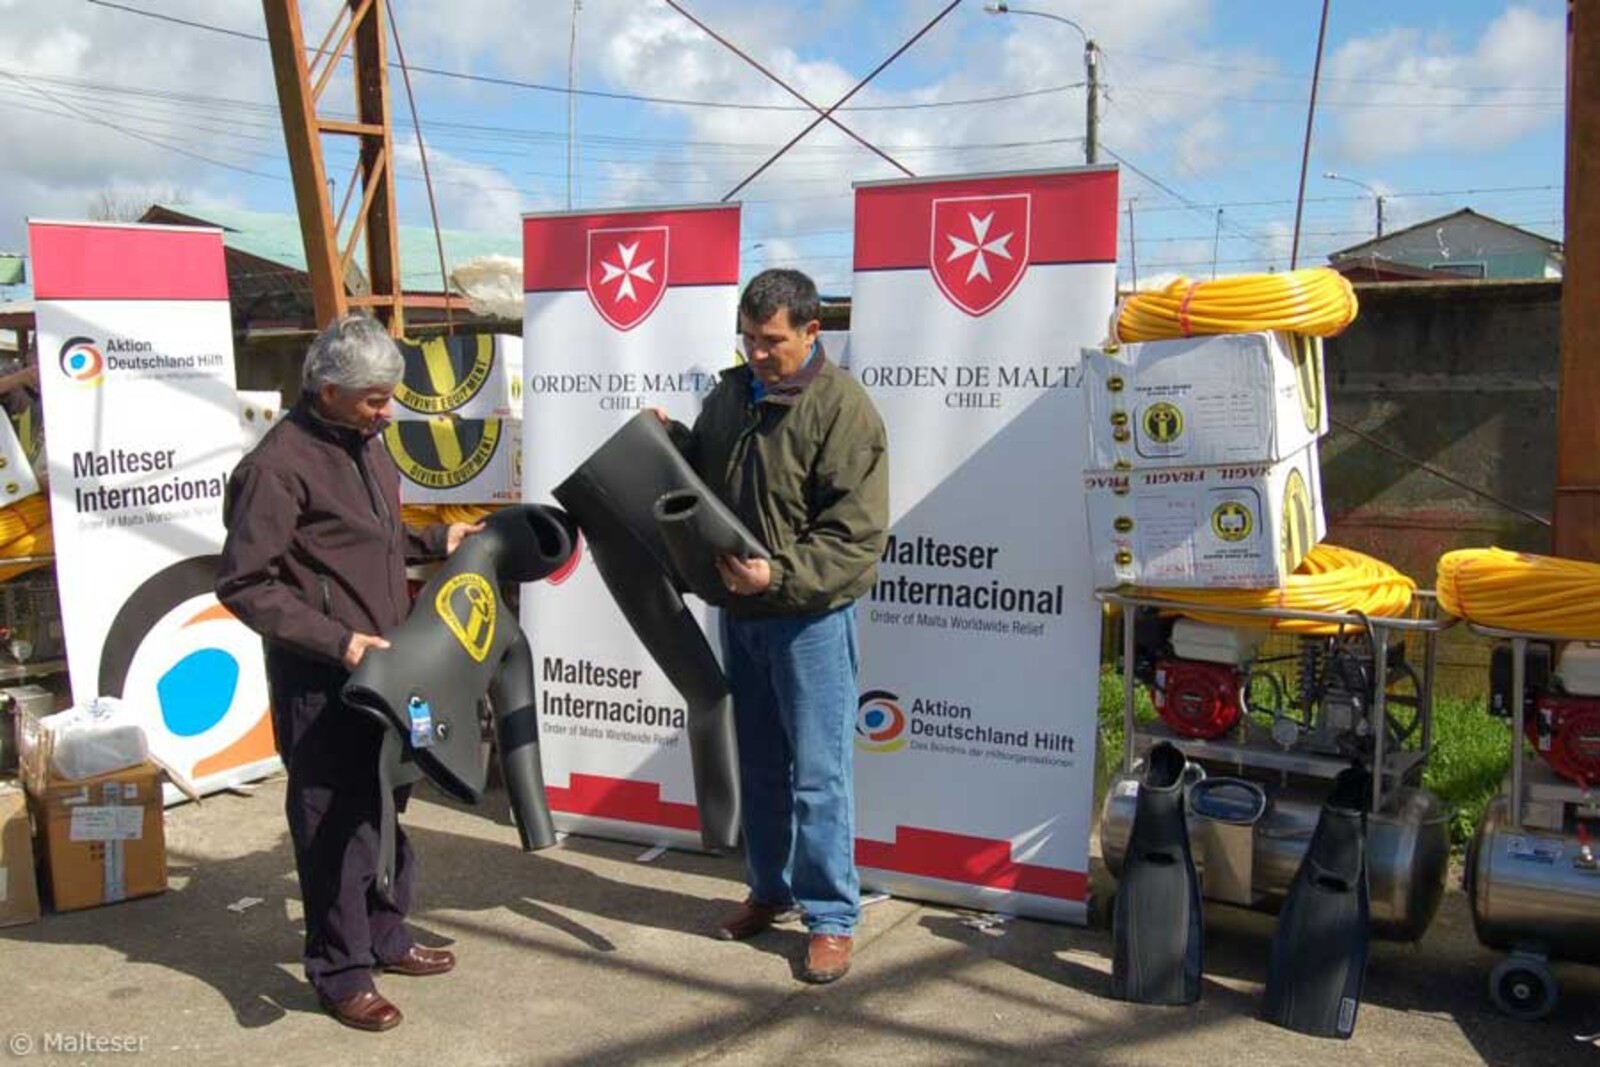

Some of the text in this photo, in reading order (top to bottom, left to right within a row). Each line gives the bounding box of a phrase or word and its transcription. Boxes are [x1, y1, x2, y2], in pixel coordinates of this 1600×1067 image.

[107, 339, 152, 352] Aktion
[108, 354, 223, 370] Deutschland Hilft
[532, 374, 601, 392] ORDEN
[609, 374, 636, 392] DE
[862, 367, 947, 387] ORDEN
[957, 367, 989, 387] DE
[600, 396, 645, 410] CHILE
[945, 392, 1001, 408] CHILE
[73, 449, 176, 479] Malteser
[447, 436, 494, 484] EQUIPMENT
[1145, 470, 1206, 486] FRAGIL
[870, 610, 1045, 637] Order of Malta Worldwide Relief
[543, 657, 642, 690] Malteser
[543, 690, 685, 729] Internaciona
[911, 698, 971, 719] Aktion
[543, 722, 567, 735] Order
[579, 726, 603, 739] Malta
[911, 718, 1075, 752] Deutschland Hilft
